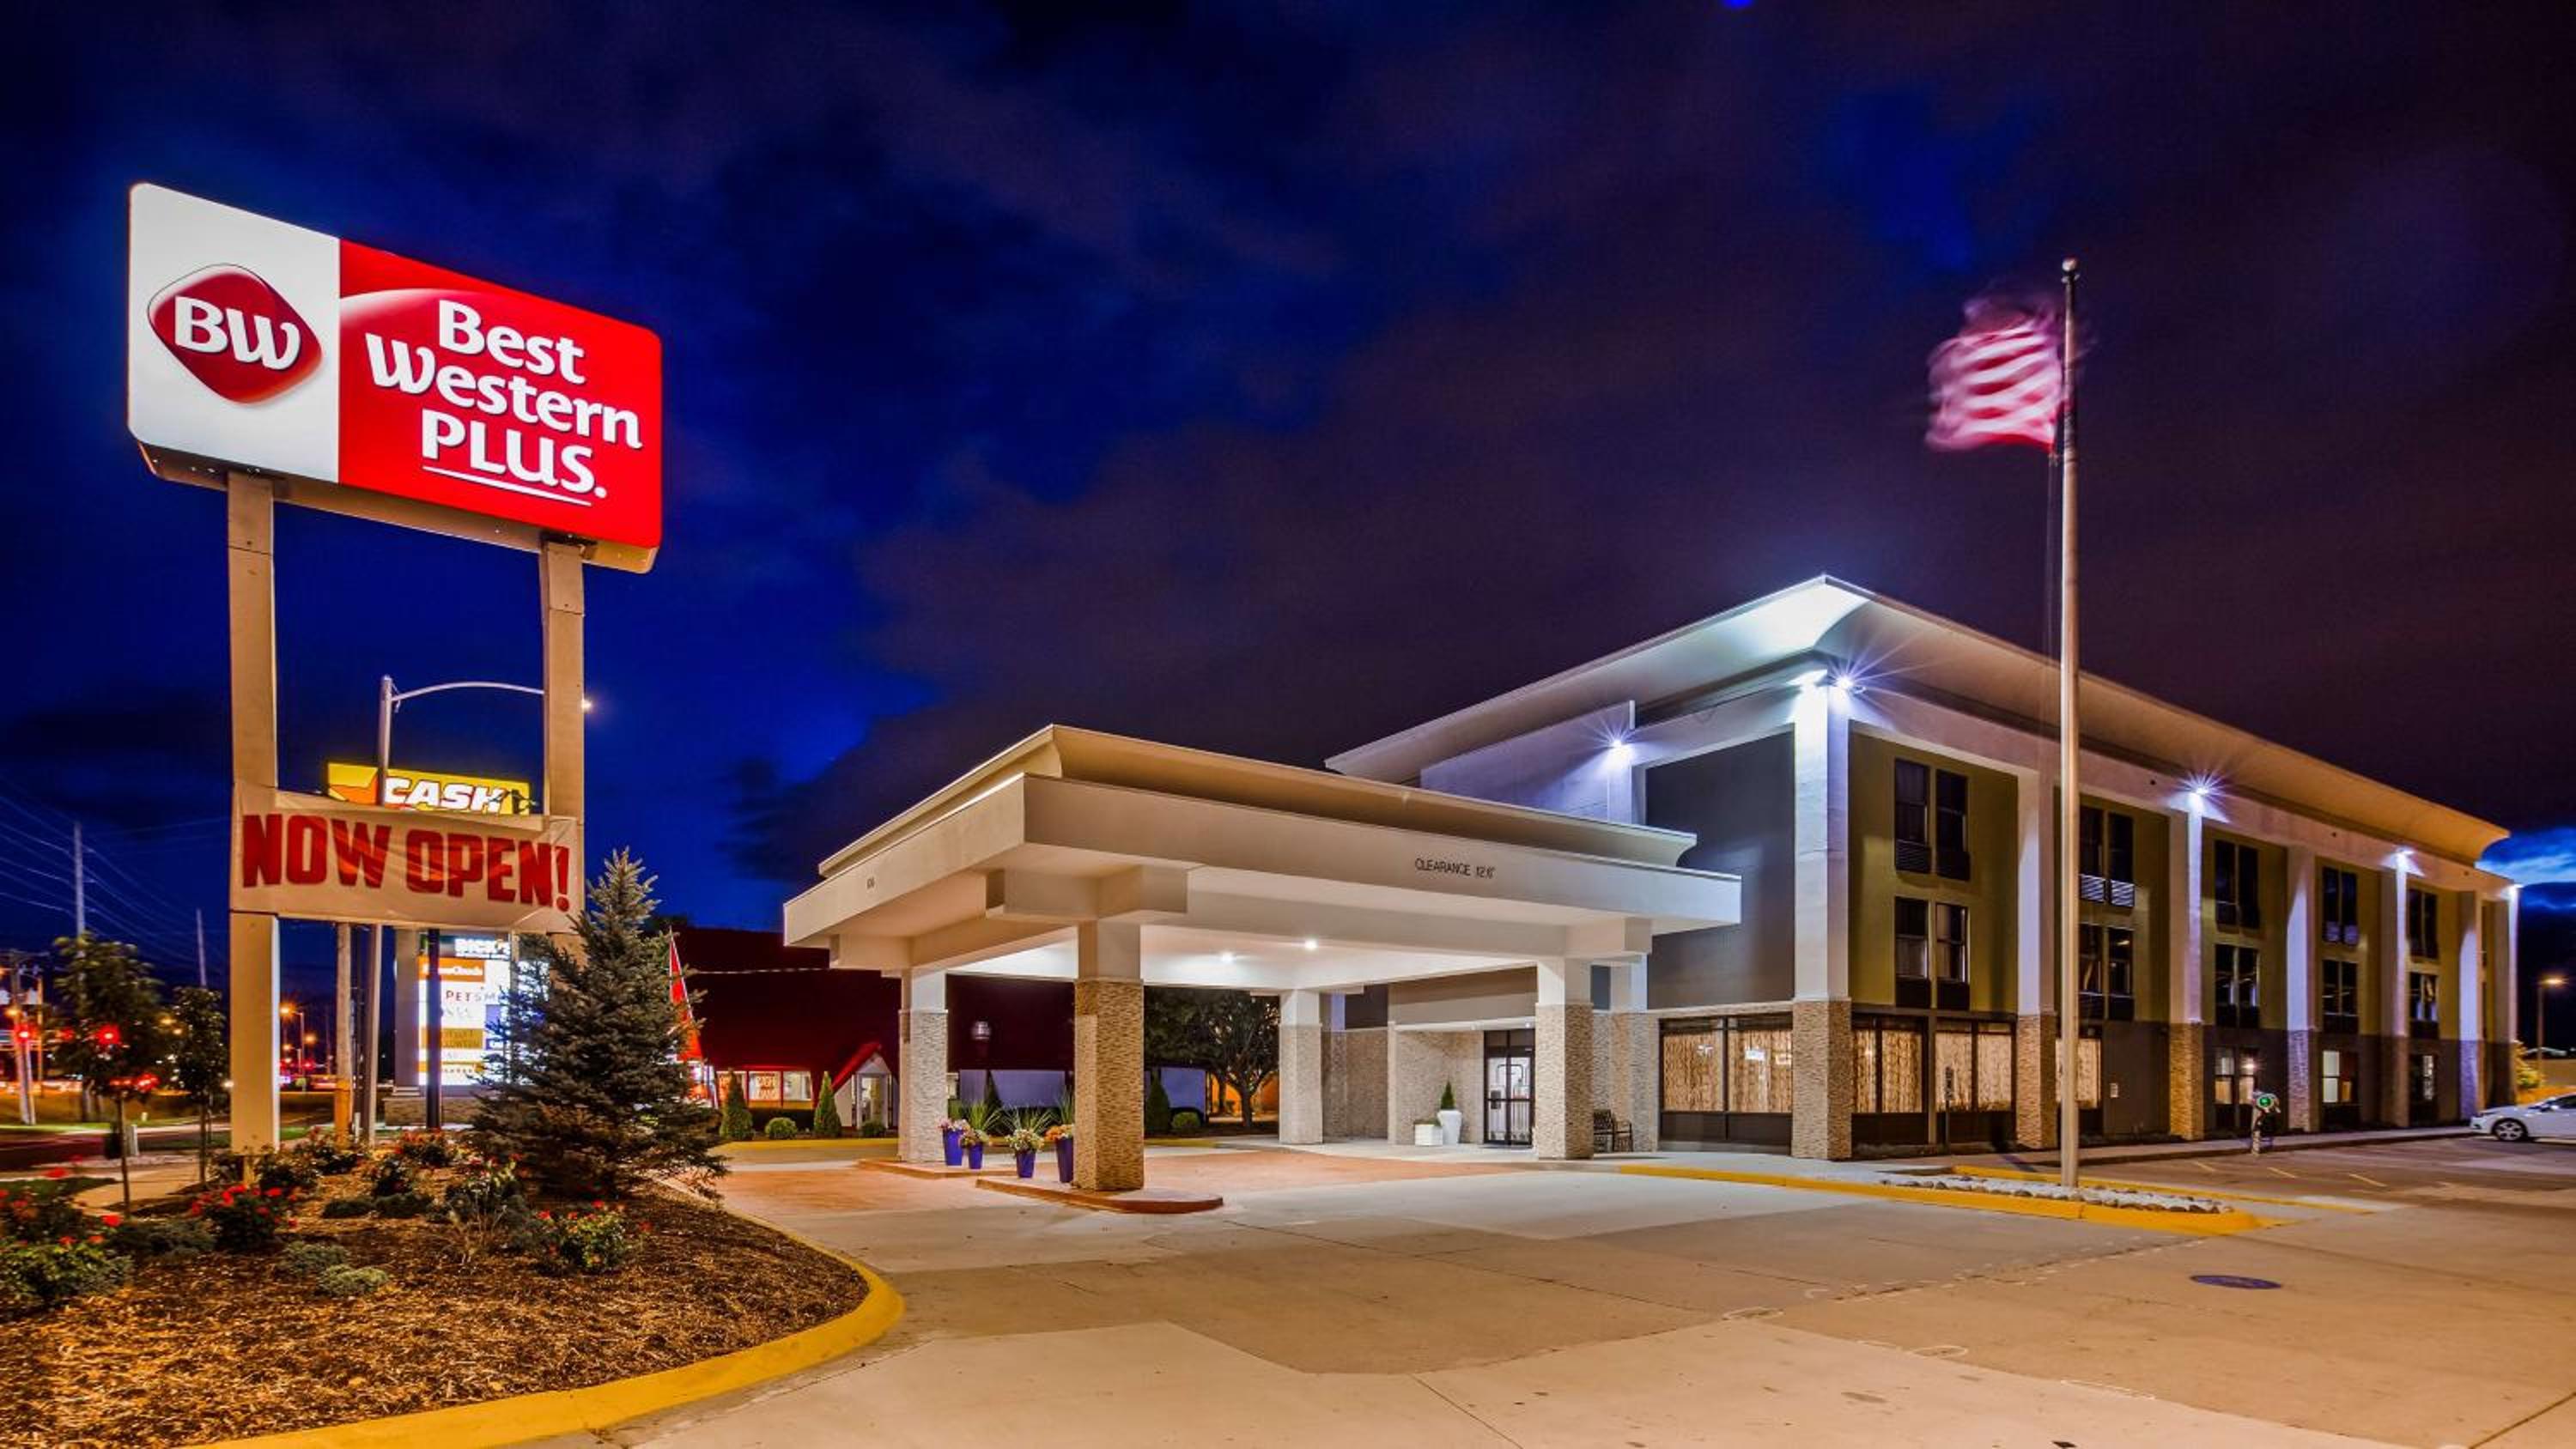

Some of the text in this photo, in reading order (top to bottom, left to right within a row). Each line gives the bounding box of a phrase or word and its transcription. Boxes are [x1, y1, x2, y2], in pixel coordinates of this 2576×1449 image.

[174, 296, 301, 371] BW
[438, 300, 586, 385] Best
[365, 331, 644, 449] Western
[421, 408, 608, 499] PLUS.
[385, 777, 505, 814] CASH
[242, 813, 570, 912] NOW OPEN!
[1414, 857, 1471, 876] CLEARANCE
